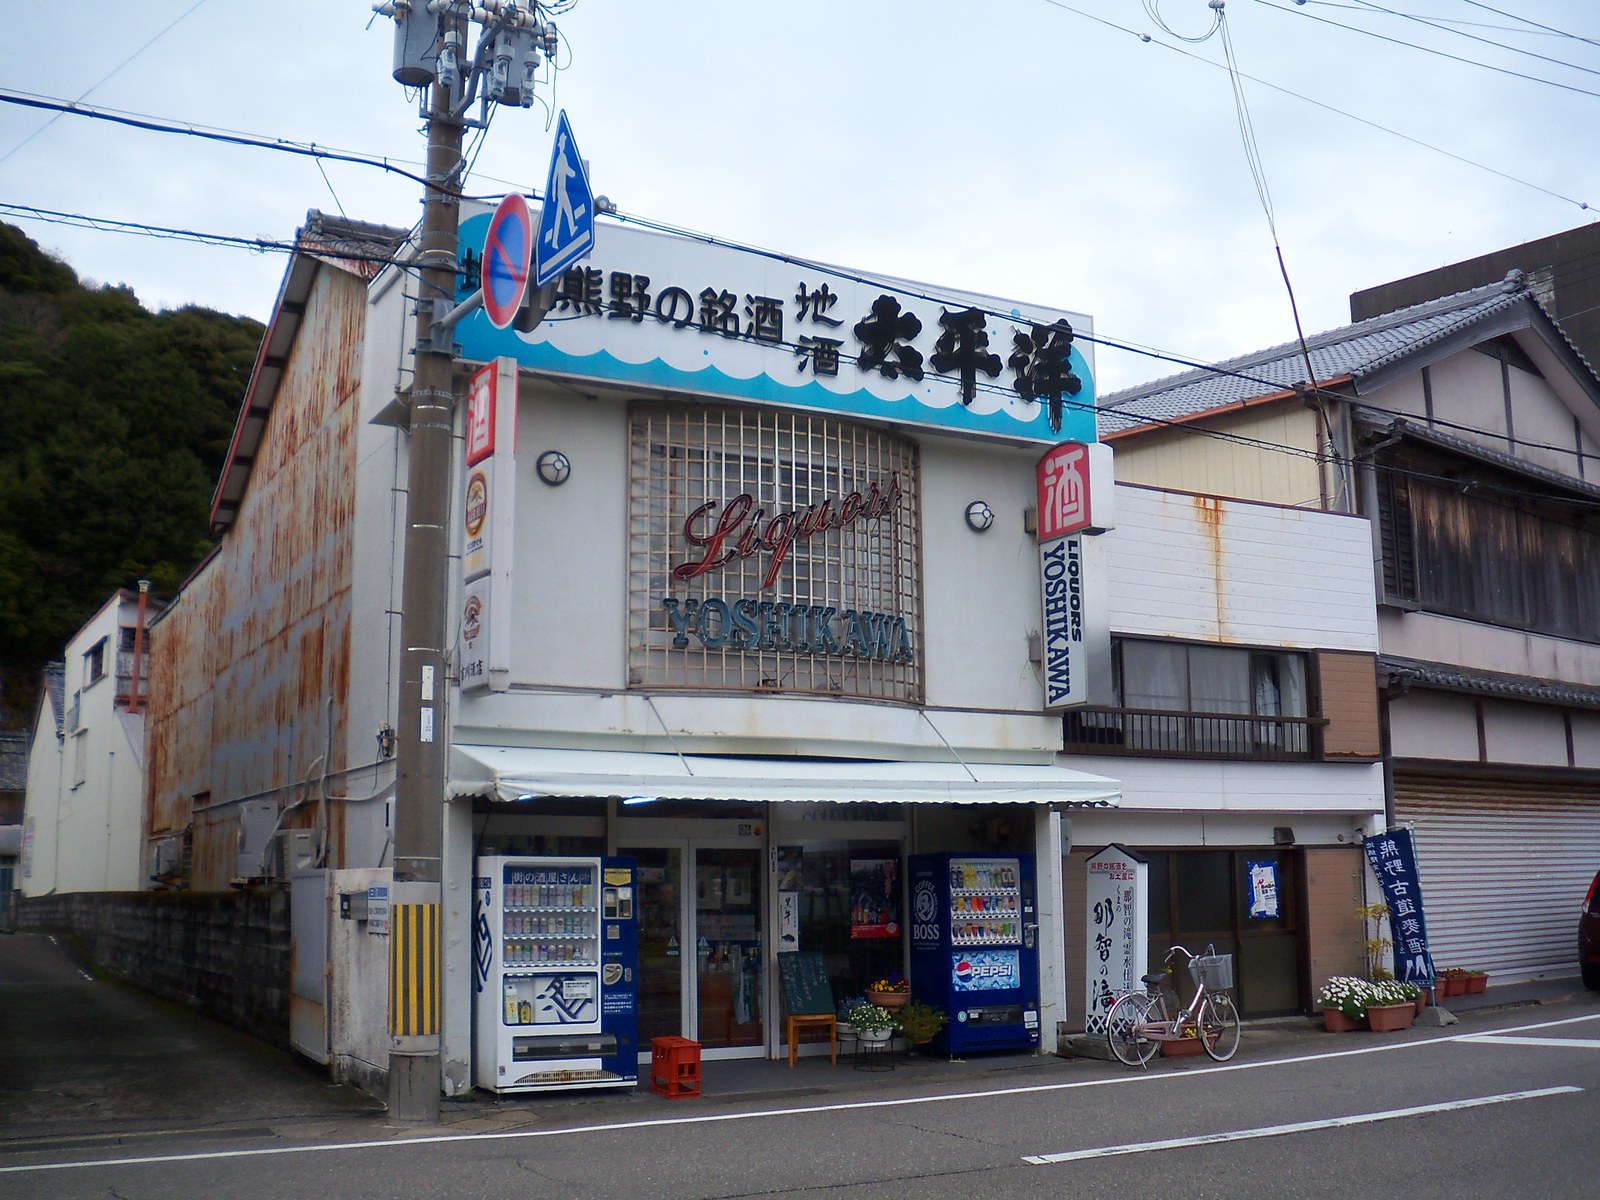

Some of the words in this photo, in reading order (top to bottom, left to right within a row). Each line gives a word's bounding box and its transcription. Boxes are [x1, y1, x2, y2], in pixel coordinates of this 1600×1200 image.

[795, 282, 844, 376] 地酒
[853, 294, 1082, 434] 太平洋
[467, 369, 491, 459] 酒
[673, 470, 903, 589] Liquors
[1044, 449, 1085, 533] 酒
[662, 597, 914, 663] YOSHIKAWA
[1043, 541, 1071, 704] YOSHIKAWA
[1067, 540, 1082, 642] LIQUORS
[513, 872, 580, 883] 街の酒屋さん
[913, 924, 940, 940] BOSS
[971, 965, 1012, 978] PEPSI
